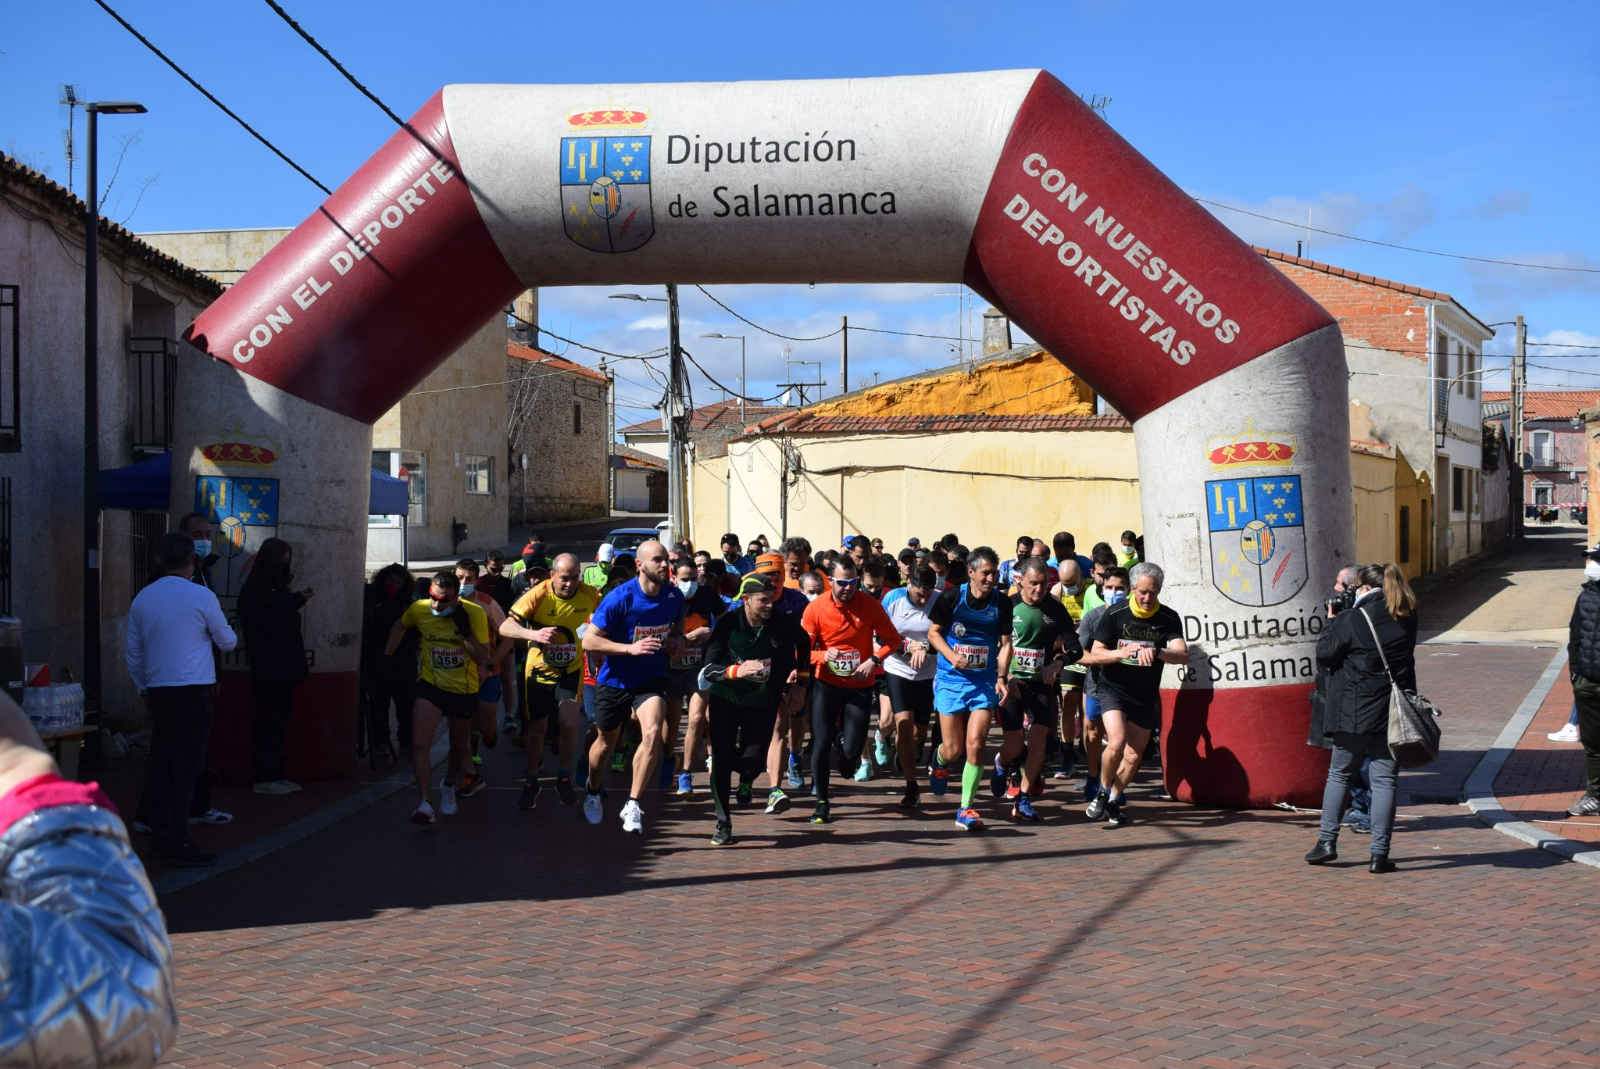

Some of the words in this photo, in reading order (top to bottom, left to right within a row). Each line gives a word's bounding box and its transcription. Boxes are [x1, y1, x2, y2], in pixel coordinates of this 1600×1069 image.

[667, 131, 856, 172] Diputación
[668, 194, 698, 218] de
[713, 184, 897, 218] Salamanca
[232, 305, 293, 363] CON
[291, 276, 333, 311] EL
[329, 157, 455, 276] DEPORTE
[1022, 153, 1088, 213] CON
[1084, 206, 1240, 344] NUESTROS
[1003, 194, 1197, 366] DEPORTISTAS
[1122, 624, 1159, 639] Kaoba
[1184, 606, 1329, 648] Diputació
[437, 656, 459, 666] 358
[549, 652, 571, 661] 303
[834, 660, 853, 670] 321
[955, 645, 988, 655] bedunia
[1017, 656, 1038, 668] 341
[1177, 664, 1198, 683] de
[1208, 651, 1313, 683] Salama
